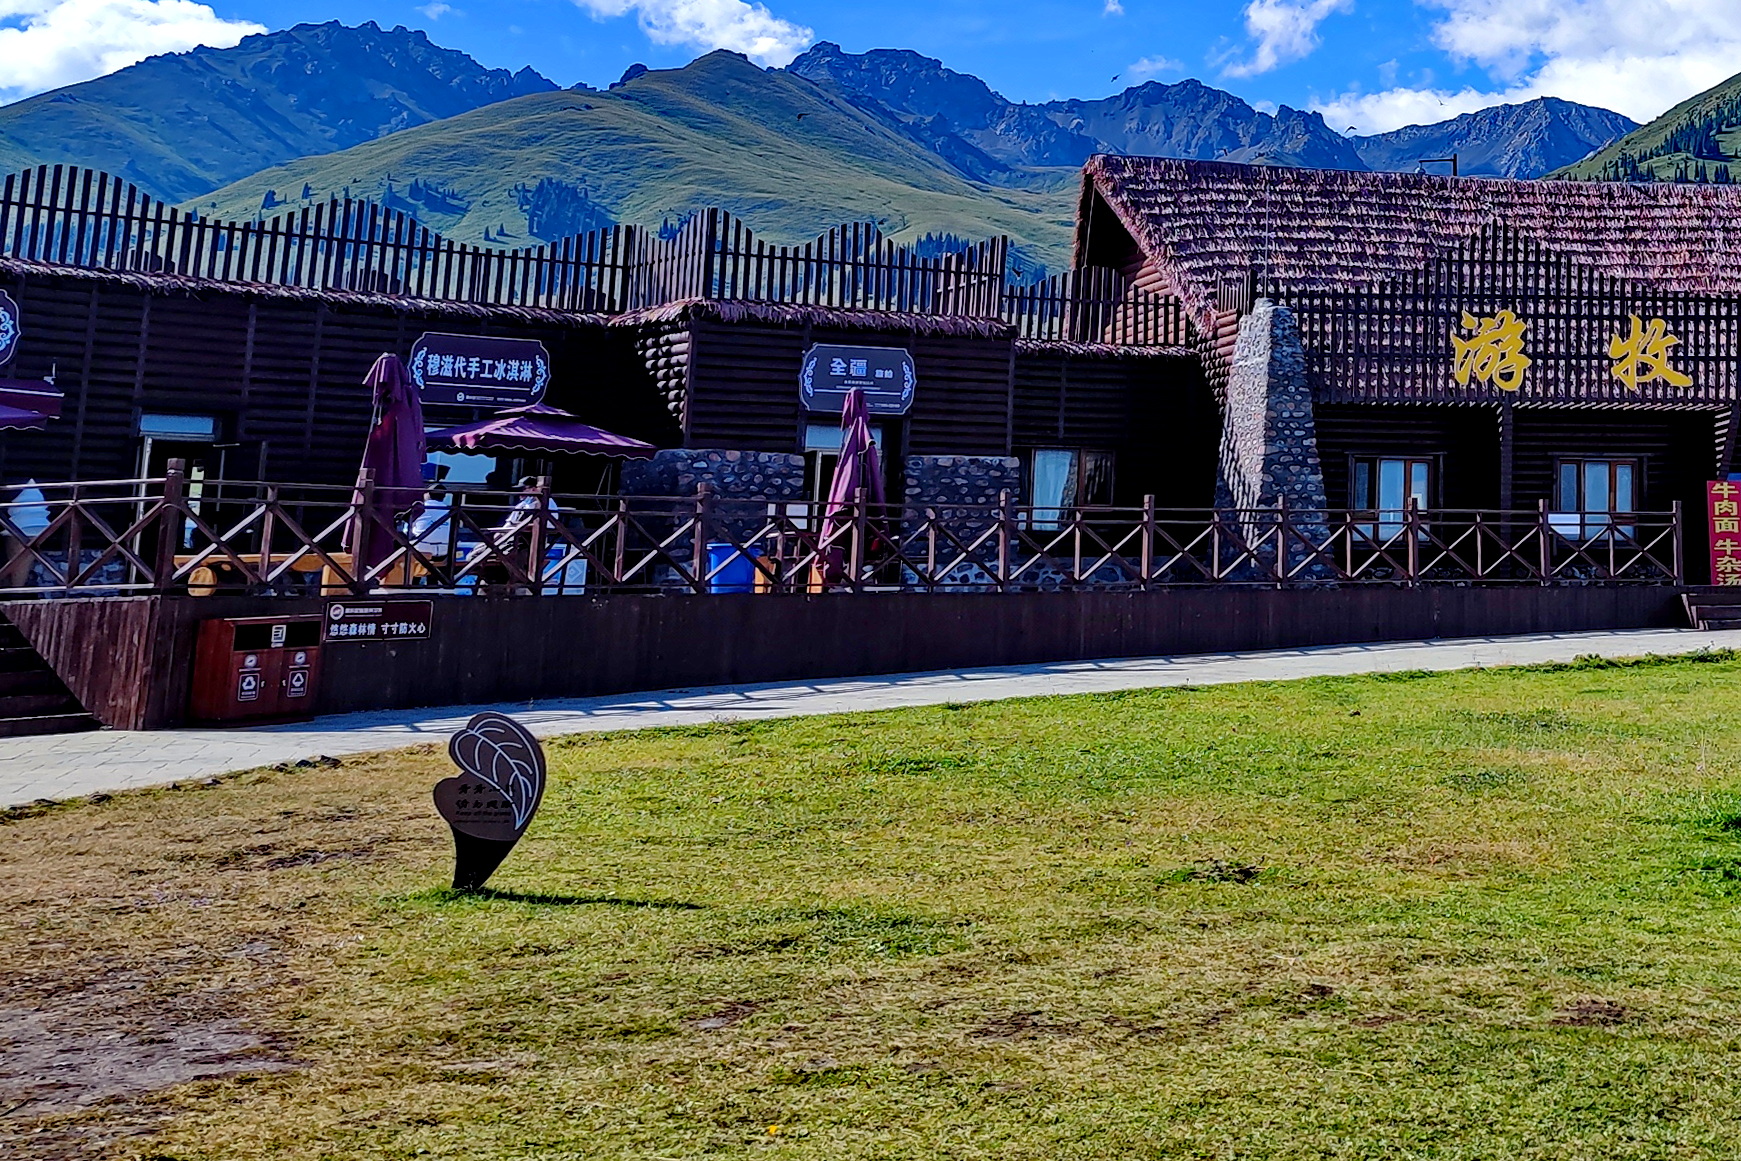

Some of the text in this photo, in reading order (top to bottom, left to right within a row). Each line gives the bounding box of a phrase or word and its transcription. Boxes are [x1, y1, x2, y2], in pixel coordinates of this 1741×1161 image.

[829, 357, 868, 377] 全疆
[1711, 482, 1740, 533] 牛肉面
